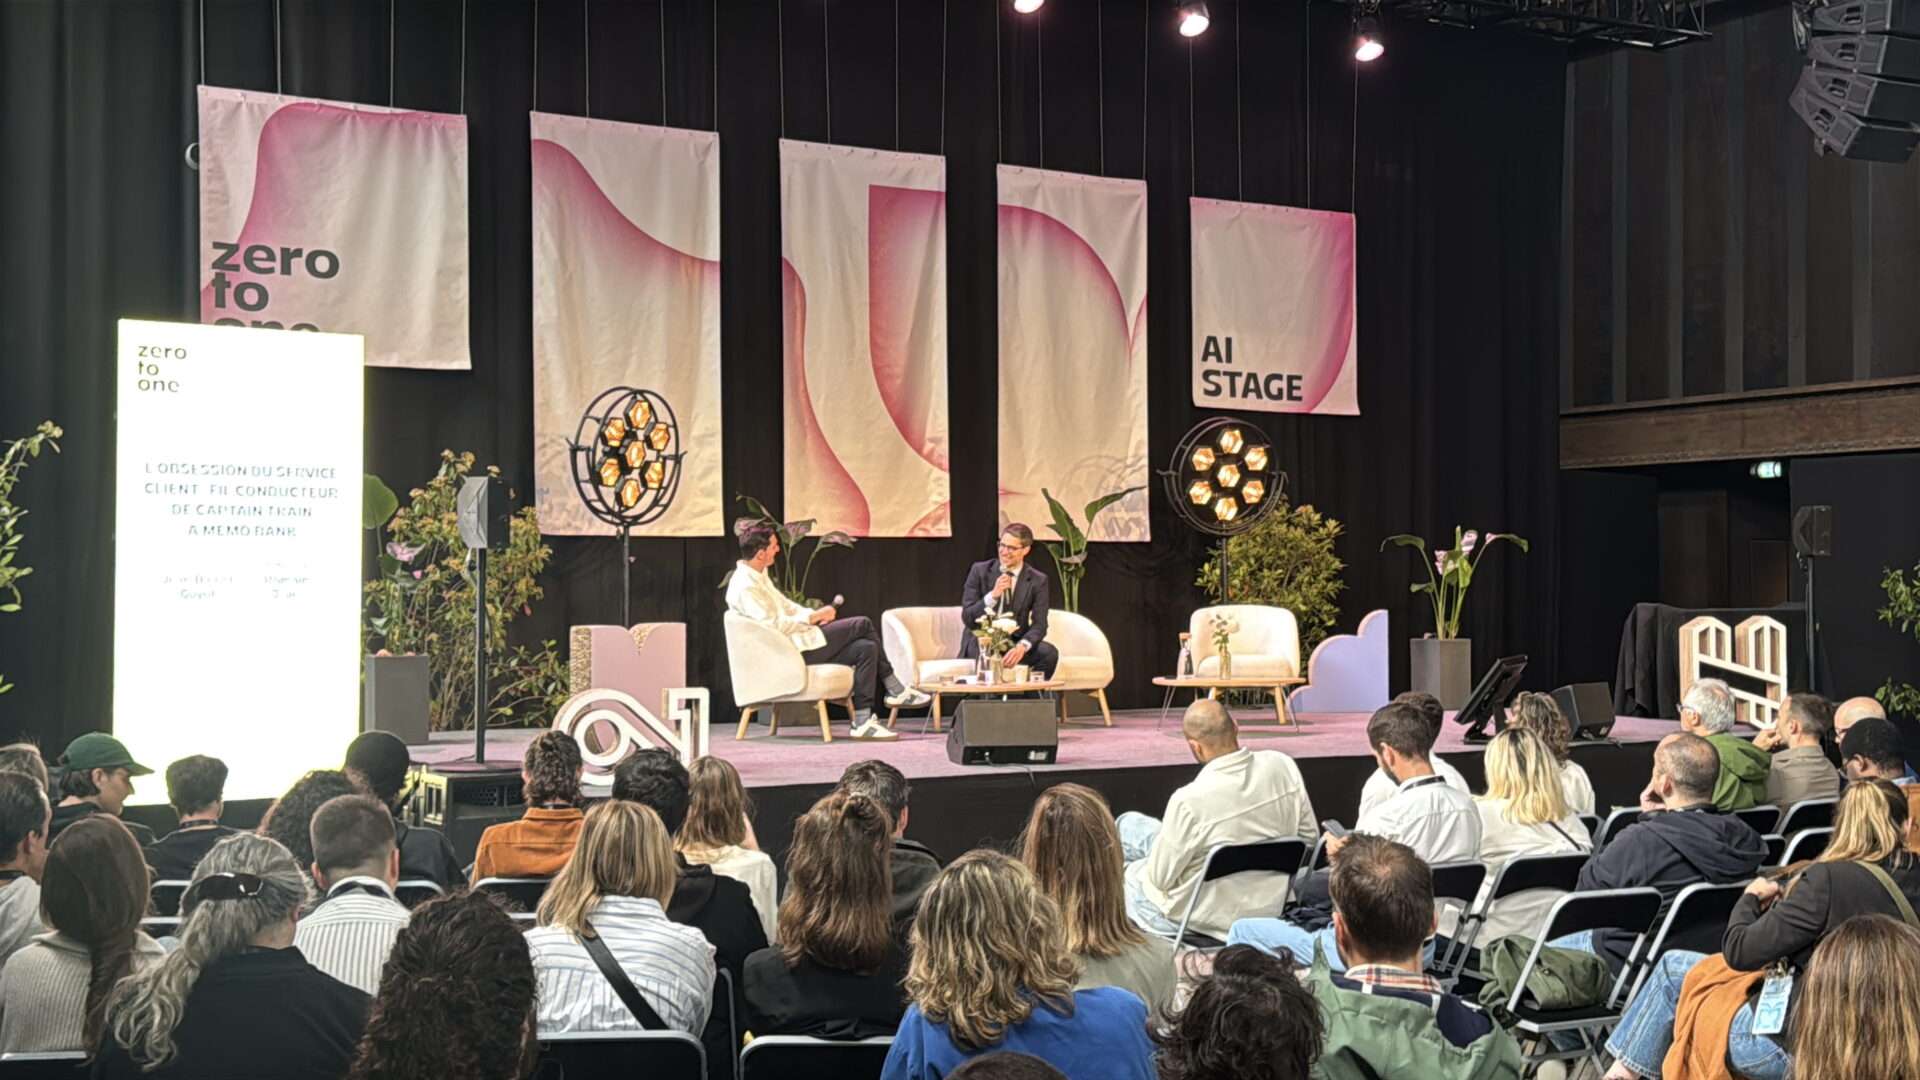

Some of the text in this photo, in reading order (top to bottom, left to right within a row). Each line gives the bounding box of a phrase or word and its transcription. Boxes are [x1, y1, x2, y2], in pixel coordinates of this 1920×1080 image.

[211, 241, 340, 279] zero
[211, 272, 269, 312] to
[138, 345, 187, 360] zero
[1201, 335, 1232, 363] AI
[138, 360, 159, 376] to
[137, 378, 180, 392] one
[1202, 369, 1303, 401] STAGE
[251, 465, 272, 478] DU
[276, 466, 336, 479] SERVICE
[235, 485, 338, 499] CONDUCTEUR
[171, 504, 312, 517] DE CAPTAIN TRAIN
[203, 525, 250, 537] MEMO
[255, 526, 297, 538] BANK
